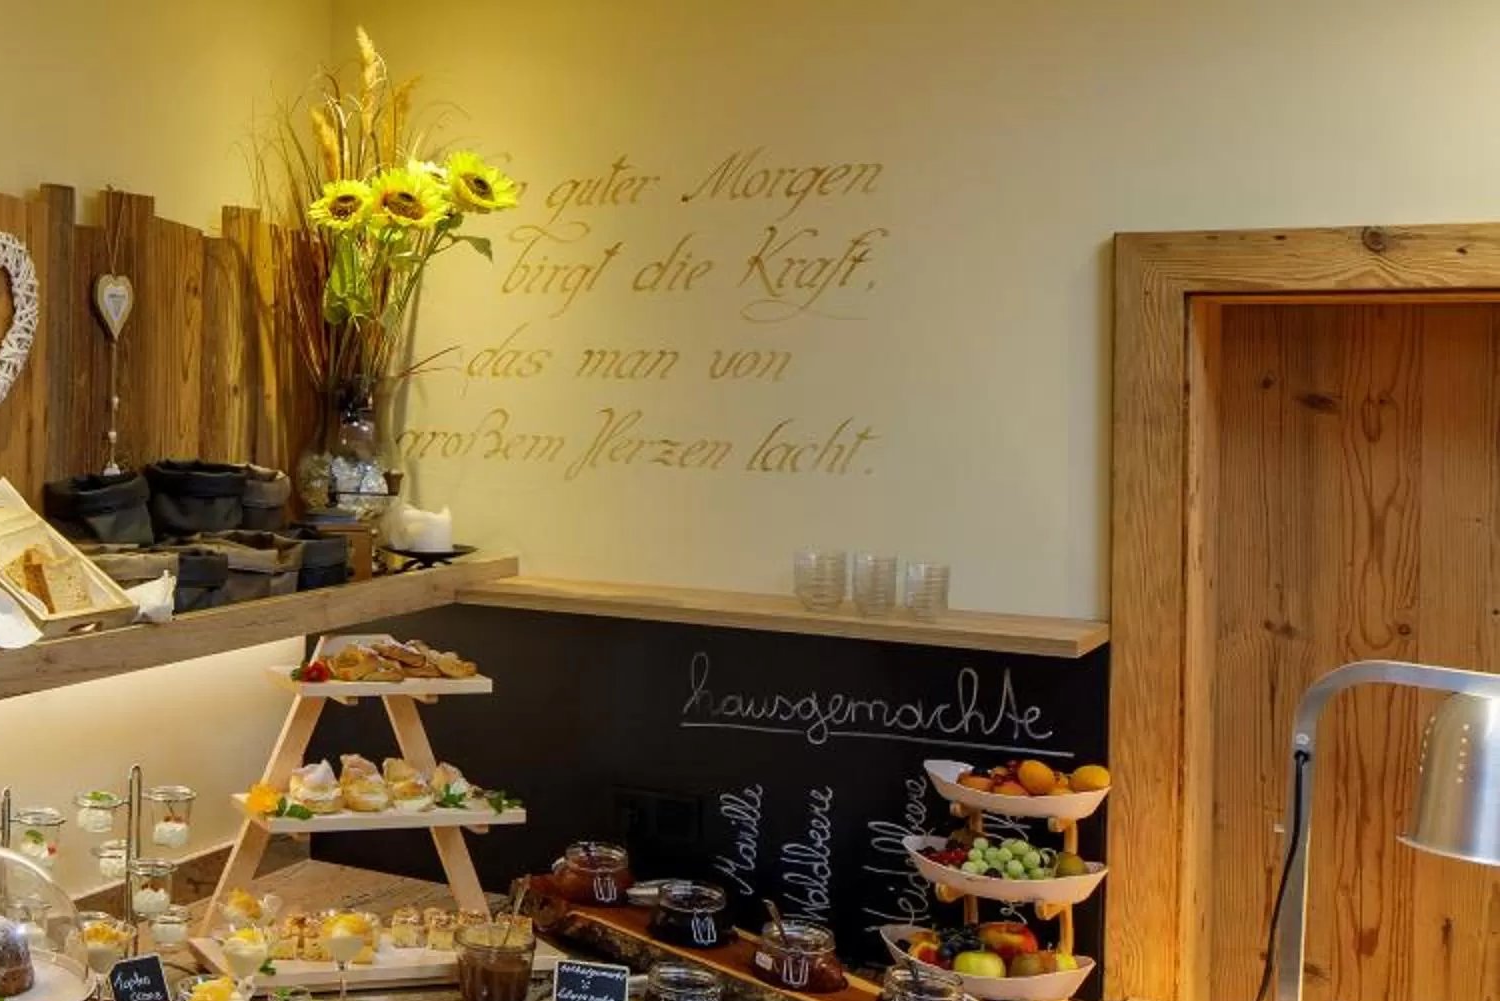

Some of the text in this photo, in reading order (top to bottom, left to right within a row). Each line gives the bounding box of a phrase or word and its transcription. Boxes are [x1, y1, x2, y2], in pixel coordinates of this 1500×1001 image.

[509, 152, 661, 242] guter
[680, 146, 885, 221] Morgen
[501, 232, 623, 319] birgt
[632, 231, 714, 293] die
[465, 322, 793, 382] das man von
[563, 407, 733, 481] Herzen
[714, 783, 764, 895] Marille
